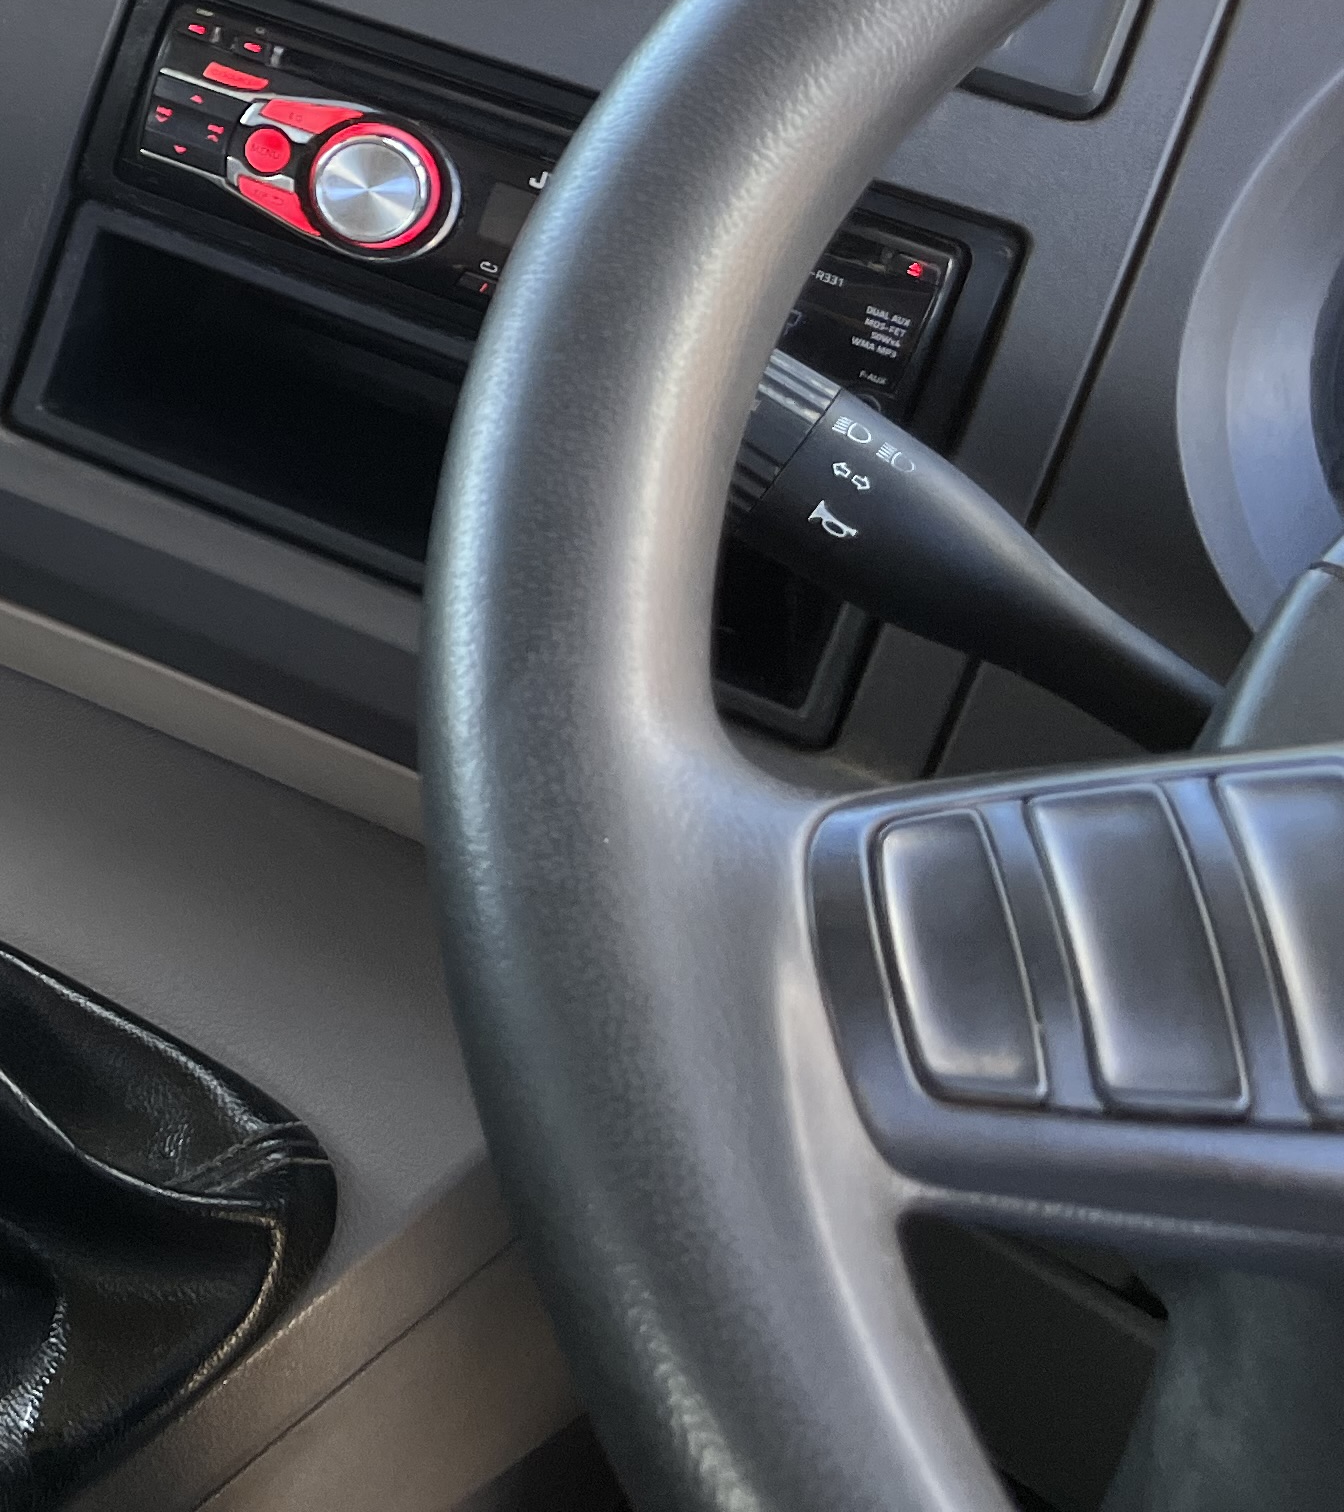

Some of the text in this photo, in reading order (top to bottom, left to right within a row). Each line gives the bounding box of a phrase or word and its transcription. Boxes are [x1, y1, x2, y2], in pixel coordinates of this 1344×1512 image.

[864, 317, 907, 338] MOS-FET
[865, 305, 912, 328] DUAL AUX
[851, 336, 898, 359] WMA MP3
